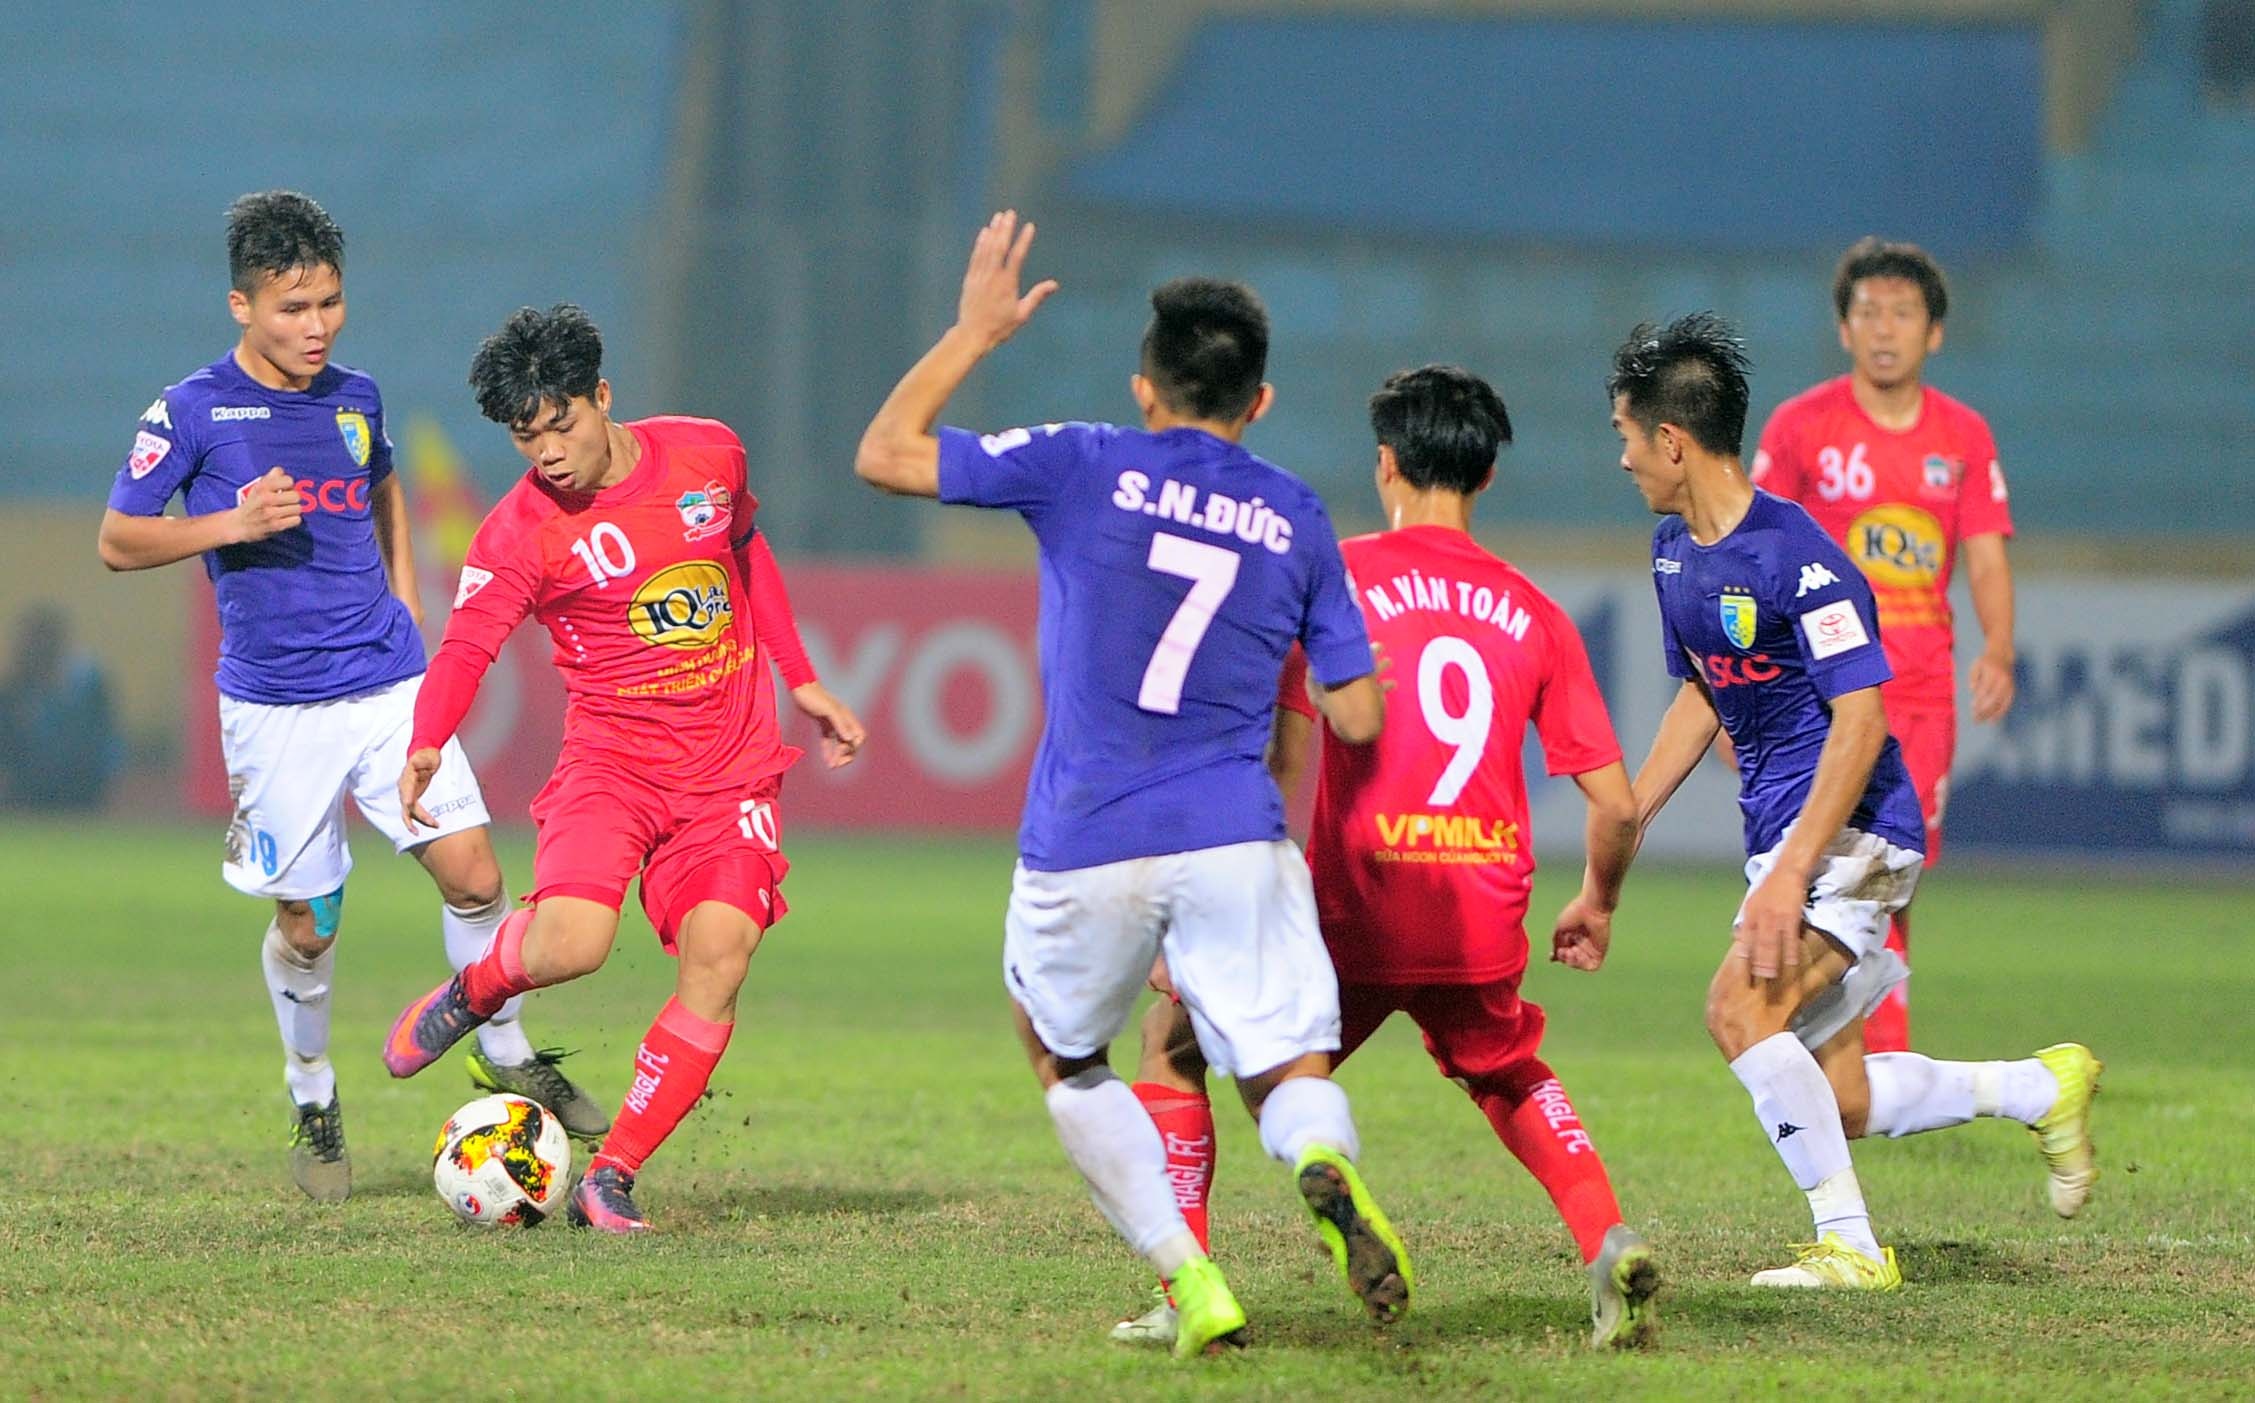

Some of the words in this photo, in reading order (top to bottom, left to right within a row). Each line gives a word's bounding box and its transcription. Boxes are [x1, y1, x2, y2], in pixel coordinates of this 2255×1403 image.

[212, 407, 271, 421] Kappa
[1817, 442, 1874, 500] 36
[1112, 470, 1293, 554] S.N.ĐỨC
[571, 521, 636, 589] 10
[645, 588, 712, 634] IQ
[1137, 531, 1241, 715] 7
[1417, 635, 1494, 806] 9
[737, 799, 778, 850] 10
[1375, 813, 1519, 849] VPMILK
[638, 1043, 670, 1075] FC
[625, 1068, 661, 1115] HAGL
[1528, 1079, 1578, 1130] HAGL
[1556, 1128, 1595, 1153] FC
[1166, 1132, 1209, 1157] FC
